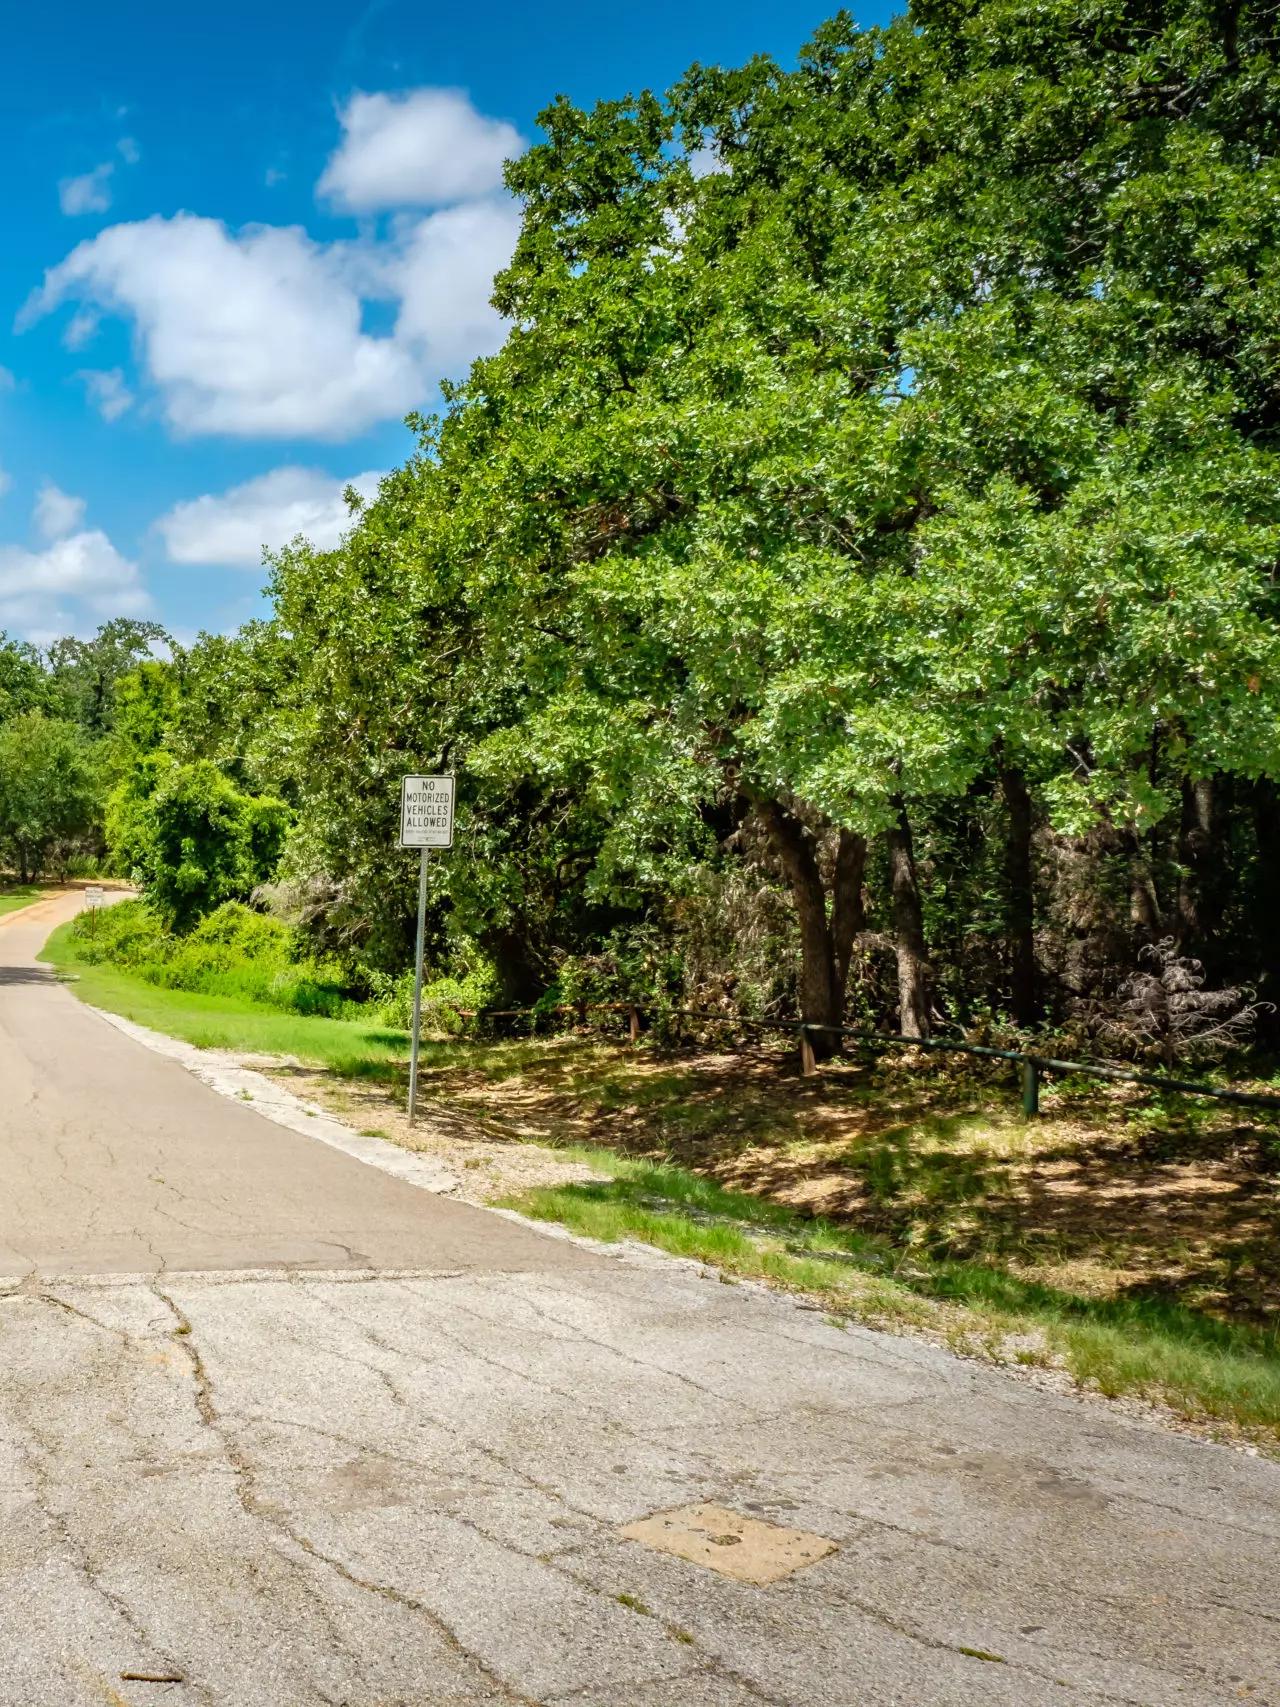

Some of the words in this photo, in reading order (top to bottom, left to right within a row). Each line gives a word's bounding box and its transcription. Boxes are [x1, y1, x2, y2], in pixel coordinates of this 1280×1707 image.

[422, 781, 435, 791] NO
[406, 793, 450, 803] MOTORIZED
[406, 805, 448, 815] VEHICLES
[406, 817, 447, 827] ALLOWED
